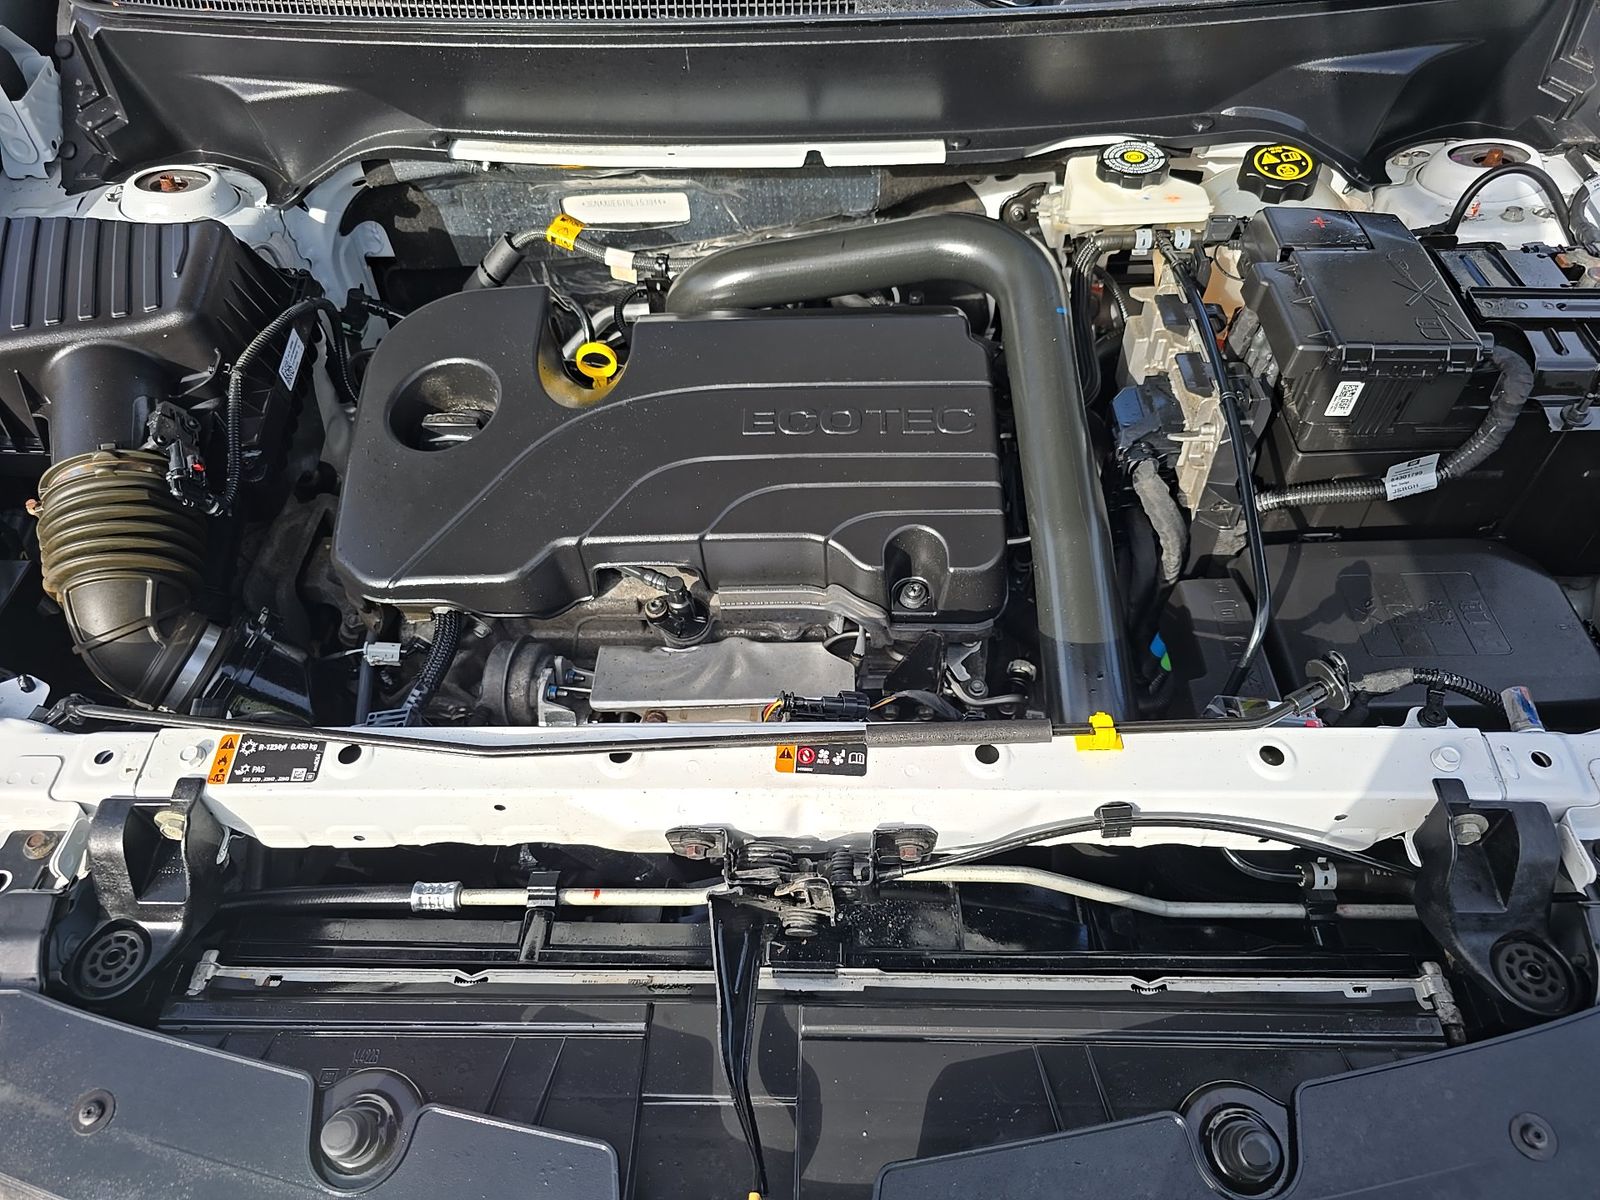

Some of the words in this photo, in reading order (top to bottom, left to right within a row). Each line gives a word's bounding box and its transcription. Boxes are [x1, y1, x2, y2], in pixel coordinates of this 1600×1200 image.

[742, 407, 976, 436] ECOTEC
[258, 743, 287, 752] R-1234yf
[308, 743, 318, 751] kg
[251, 765, 266, 773] PAG
